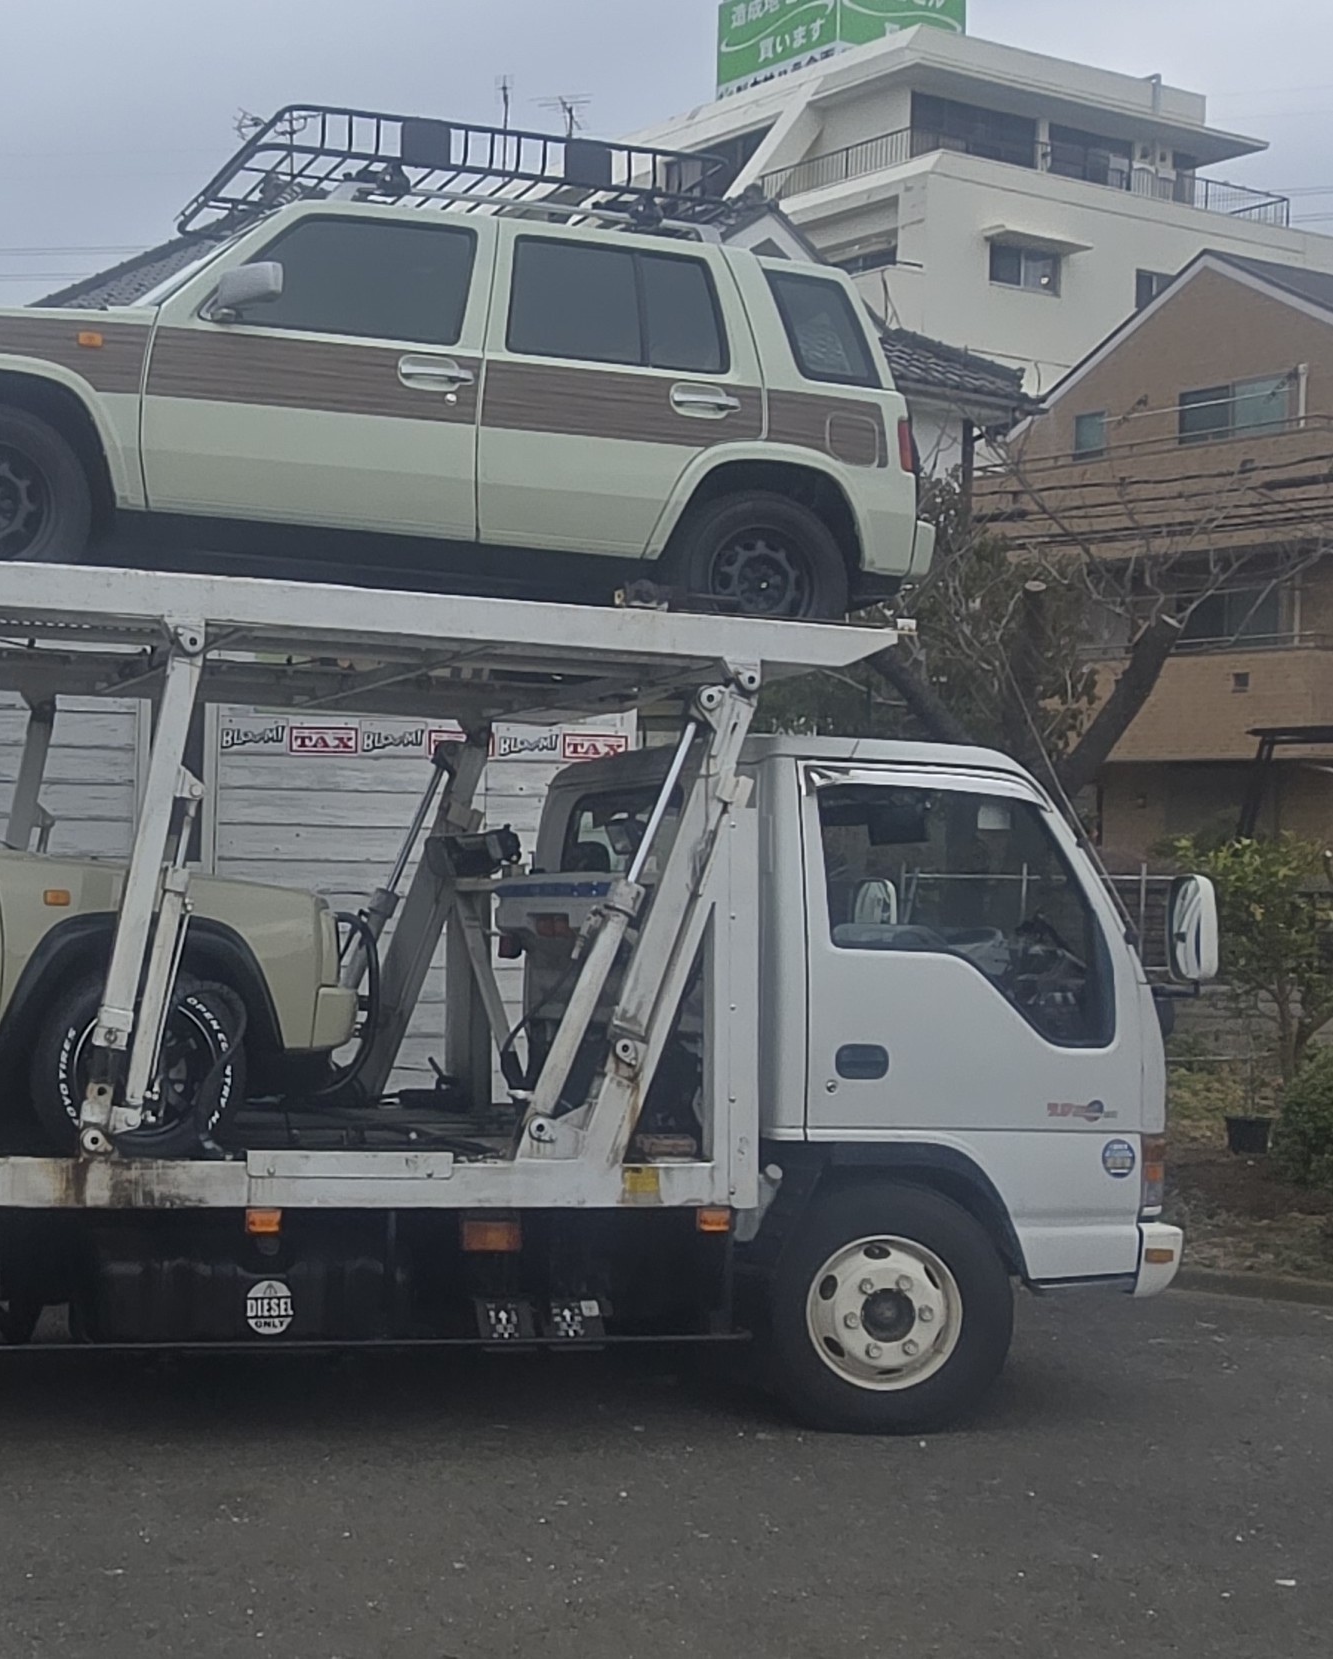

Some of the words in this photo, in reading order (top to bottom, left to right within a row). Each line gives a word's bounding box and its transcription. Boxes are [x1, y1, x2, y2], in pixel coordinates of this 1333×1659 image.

[758, 17, 826, 63] 買います
[293, 735, 354, 749] TAX
[186, 997, 221, 1030] OPEN
[59, 1027, 76, 1080] TIRES
[246, 1298, 294, 1317] DIESEL
[254, 1320, 284, 1329] ONLY
